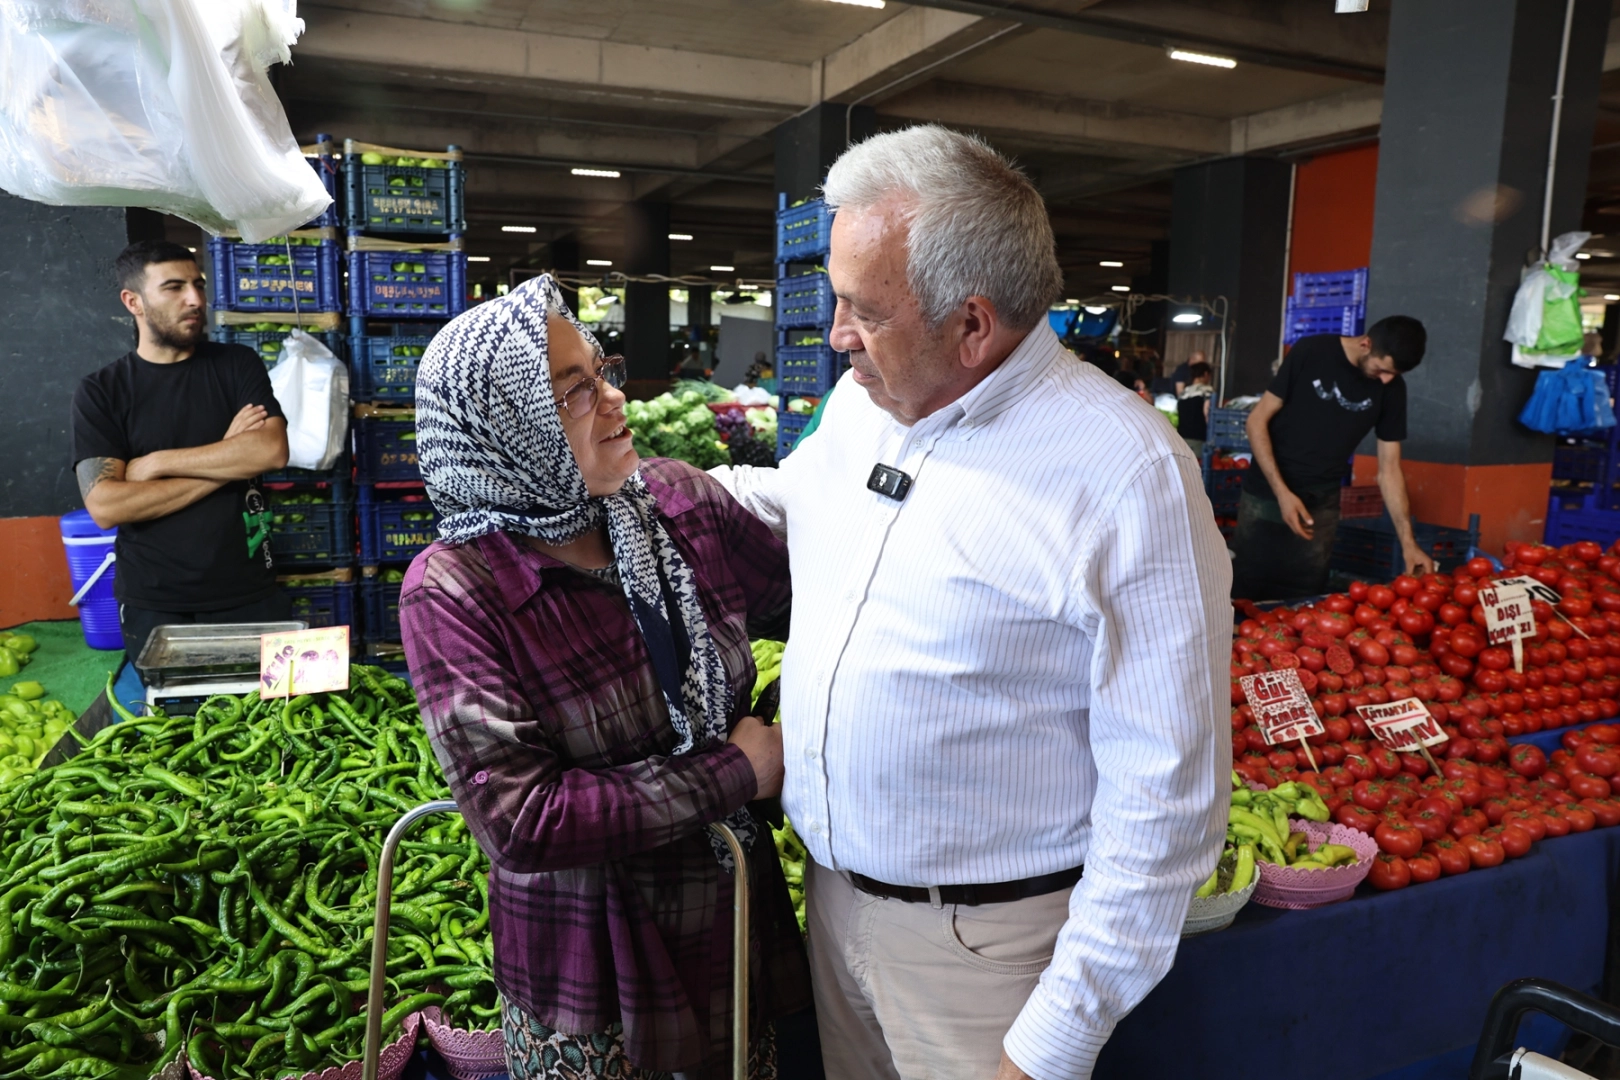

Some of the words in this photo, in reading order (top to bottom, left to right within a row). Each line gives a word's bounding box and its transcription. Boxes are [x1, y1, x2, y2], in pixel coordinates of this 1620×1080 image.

[1497, 603, 1521, 621] DIŞI
[1489, 621, 1531, 644] KIRMZI
[1254, 677, 1291, 700] GÜL
[1262, 706, 1309, 728] PEMBE
[1359, 701, 1419, 723] KÜTAHYA
